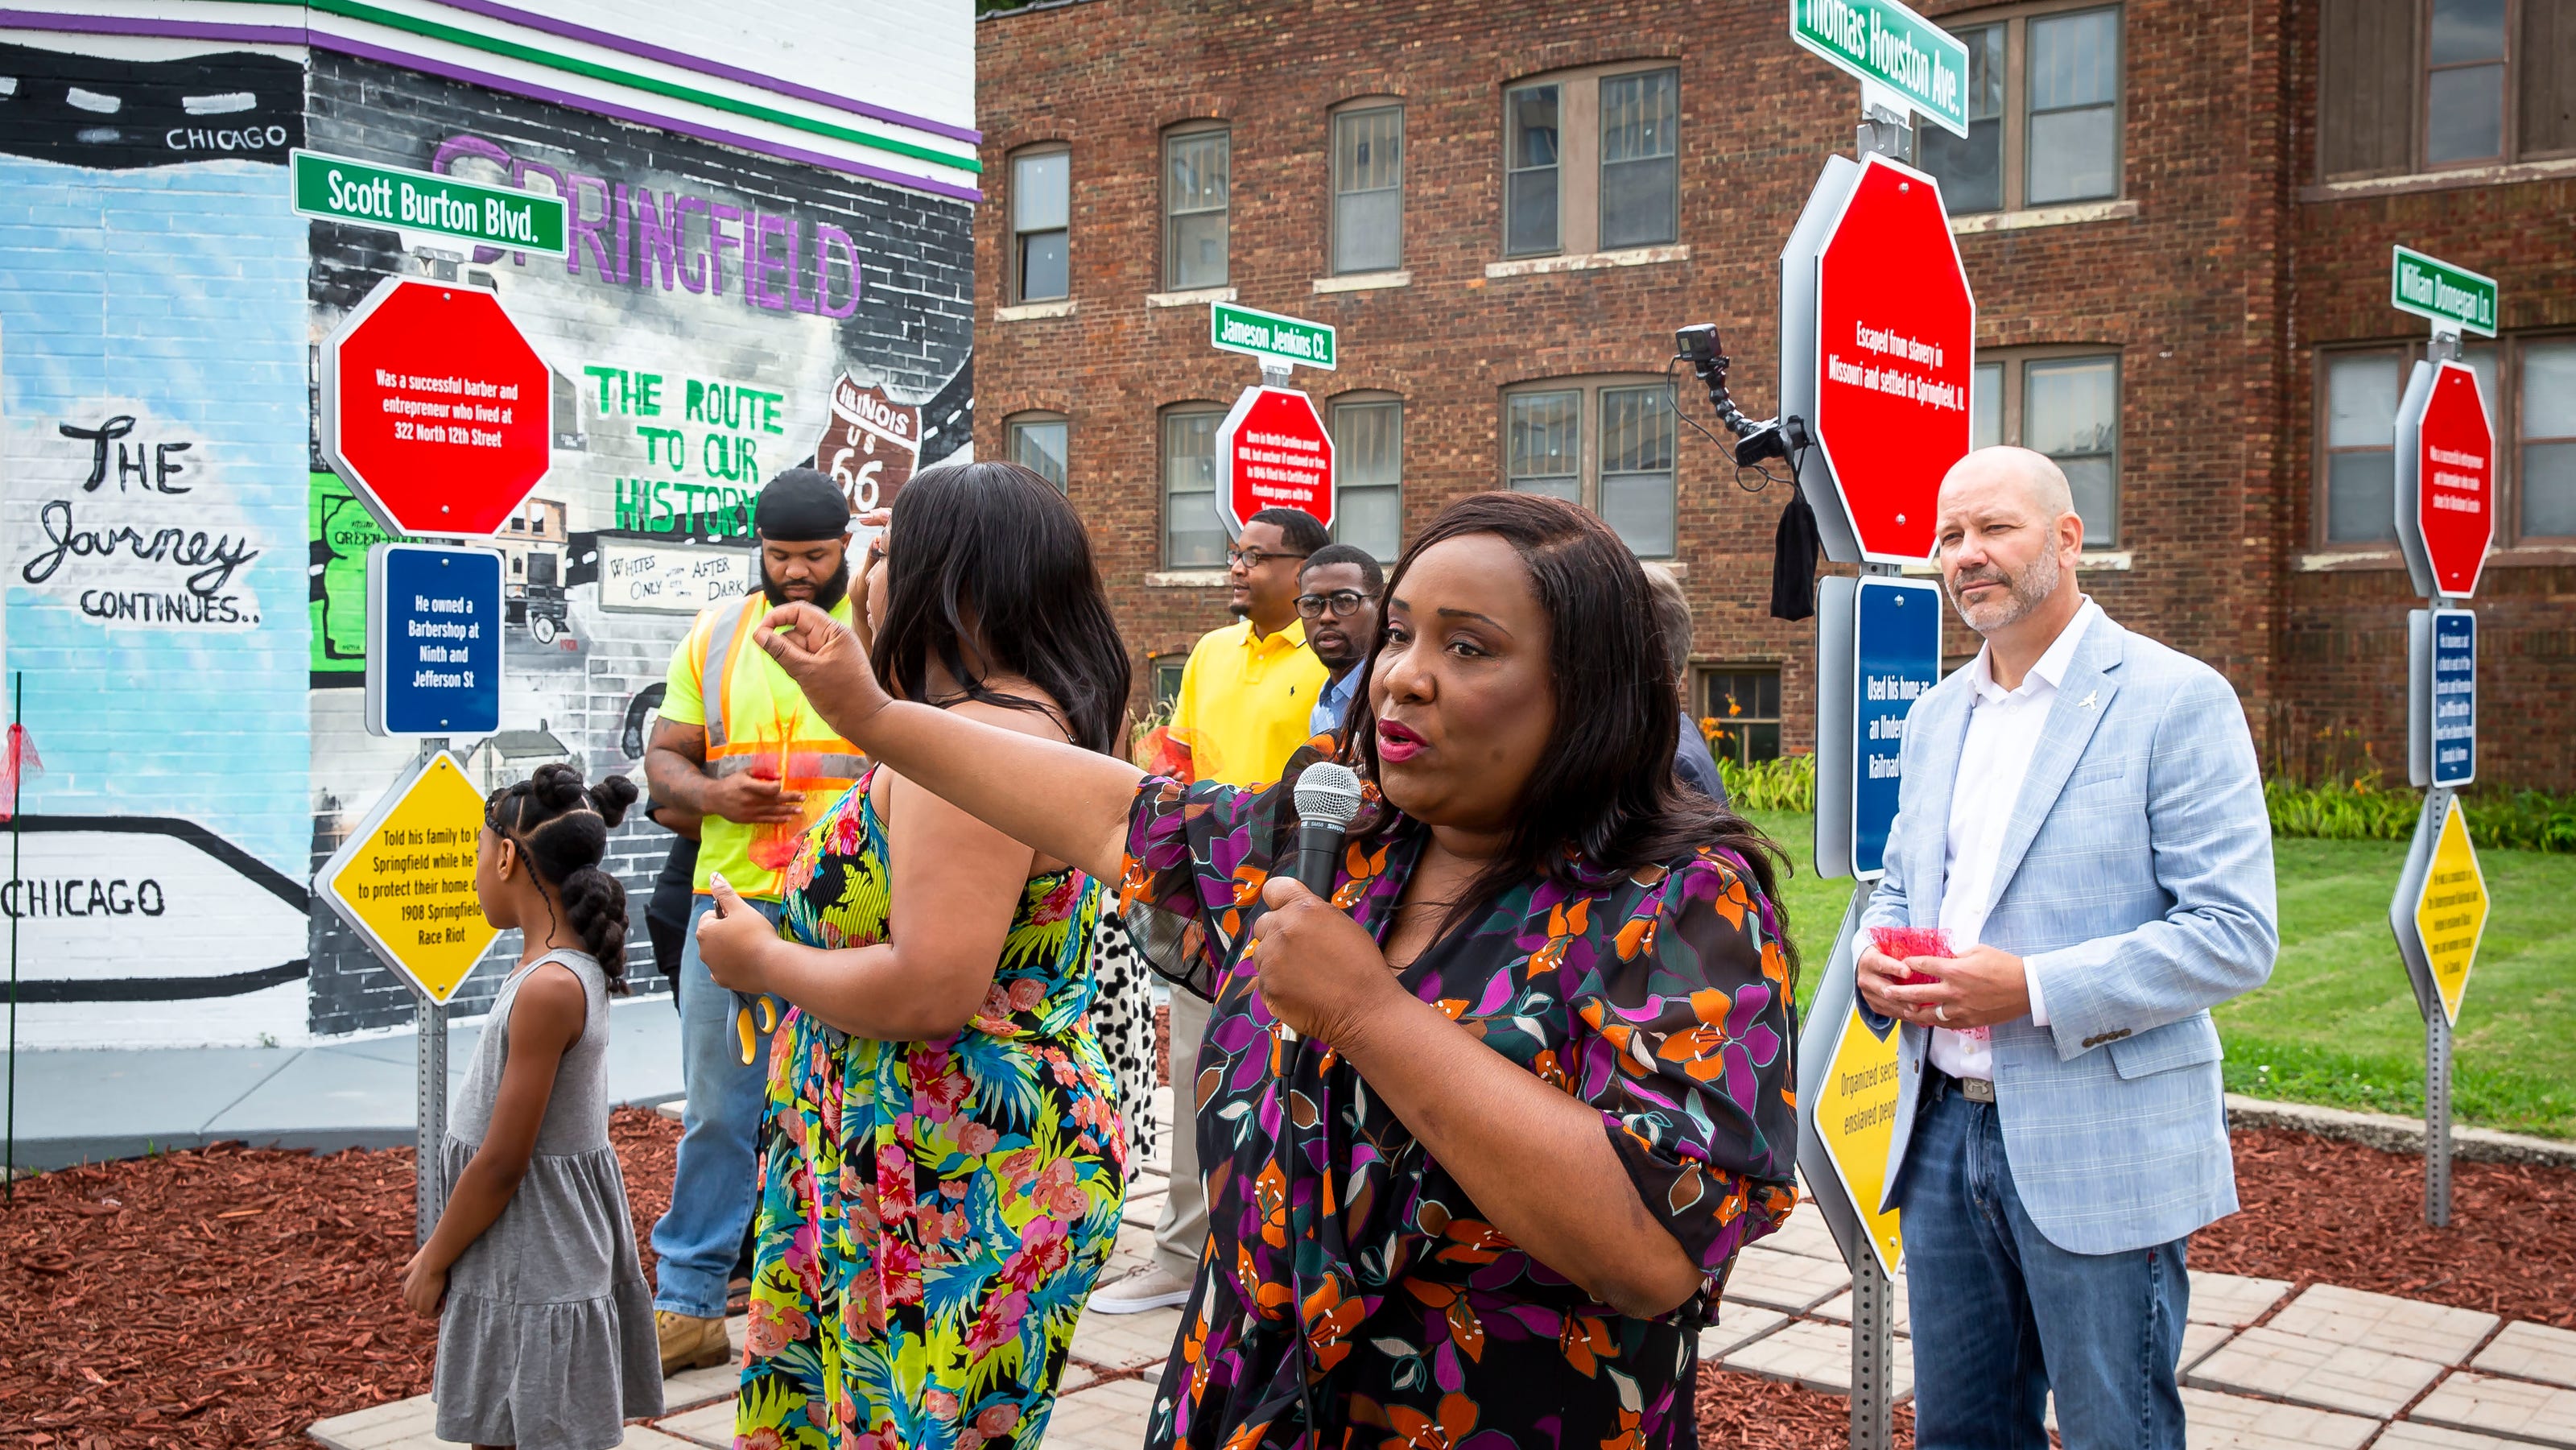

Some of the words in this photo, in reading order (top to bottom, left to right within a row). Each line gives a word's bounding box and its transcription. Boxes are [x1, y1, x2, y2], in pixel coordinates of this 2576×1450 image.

[1870, 8, 1929, 98] Houston
[1932, 49, 1960, 117] Ave.
[166, 125, 287, 150] CHICAGO
[328, 169, 393, 219] Scott
[400, 182, 477, 233] Burton
[485, 197, 539, 243] Blvd.
[2401, 262, 2434, 306] William
[2434, 273, 2477, 322] Donnegan
[2479, 289, 2491, 324] Ln.
[1220, 313, 1269, 349] Jameson
[1271, 324, 1311, 357] Jenkins
[1312, 333, 1328, 361] Ct.
[1856, 320, 1888, 356] Escaped
[1889, 329, 1907, 359] from
[1909, 336, 1934, 371] slavery
[1935, 342, 1942, 368] in
[375, 368, 397, 388] Was
[399, 374, 407, 389] a
[408, 376, 462, 395] successful
[464, 378, 497, 398] barber
[499, 383, 518, 400] and
[1828, 353, 1863, 386] Missouri
[1864, 366, 1879, 390] and
[1880, 369, 1907, 398] settled
[1908, 374, 1915, 399] in
[1917, 375, 1956, 411] Springfield,
[1957, 387, 1964, 411] IL
[382, 395, 451, 418] entrepreneur
[452, 403, 473, 420] who
[475, 404, 499, 423] lived
[502, 407, 513, 424] at
[584, 366, 663, 416] THE
[686, 379, 783, 436] ROUTE
[839, 383, 910, 436] ILLINOIS
[394, 421, 414, 440] 322
[416, 423, 445, 443] North
[448, 426, 469, 445] 12th
[471, 428, 502, 448] Street
[1260, 432, 1265, 444] in
[1265, 433, 1281, 446] North
[1282, 435, 1302, 449] Carolina
[1302, 440, 1319, 452] around
[59, 415, 192, 494] THE
[637, 425, 684, 472] TO
[704, 433, 758, 485] OUR
[1252, 448, 1261, 461] but
[1282, 452, 1287, 465] if
[1308, 458, 1315, 468] or
[830, 448, 883, 513] 66
[1265, 466, 1278, 481] filed
[1278, 469, 1287, 481] his
[1287, 469, 1313, 485] Certificate
[1313, 473, 1319, 485] of
[1252, 482, 1274, 498] Freedom
[1274, 487, 1292, 501] papers
[1292, 488, 1303, 501] with
[1303, 489, 1313, 502] the
[615, 477, 759, 539] HISTORY
[22, 499, 259, 597] Journey
[610, 556, 655, 579] WHITES
[692, 557, 730, 578] AFTER
[630, 580, 662, 600] ONLY
[708, 580, 745, 601] DARK
[80, 589, 259, 623] CONTINUES..
[415, 595, 429, 612] He
[431, 597, 464, 613] owned
[465, 600, 473, 613] a
[408, 619, 466, 642] Barbershop
[468, 622, 480, 638] at
[419, 645, 447, 662] Ninth
[449, 647, 469, 663] and
[412, 670, 460, 688] Jefferson
[463, 671, 474, 688] St
[1868, 675, 1886, 700] Used
[1887, 675, 1899, 700] his
[1900, 675, 1920, 700] home
[1869, 720, 1879, 740] an
[1880, 714, 1905, 740] Under
[1869, 753, 1899, 779] Railroad
[384, 830, 405, 846] Told
[408, 828, 423, 845] his
[427, 828, 457, 846] family
[460, 827, 471, 842] to
[373, 853, 429, 875] Springfield
[432, 853, 458, 869] while
[461, 853, 473, 867] he
[1, 878, 165, 918] CHICAGO
[358, 882, 369, 899] to
[373, 880, 410, 901] protect
[415, 878, 439, 895] their
[441, 878, 469, 893] home
[402, 904, 425, 921] 1908
[428, 901, 482, 922] Springfield
[418, 929, 442, 945] Race
[445, 927, 465, 943] Riot
[1841, 1061, 1878, 1100] Organized
[1880, 1060, 1898, 1083] secre
[1844, 1101, 1876, 1135] enslaved
